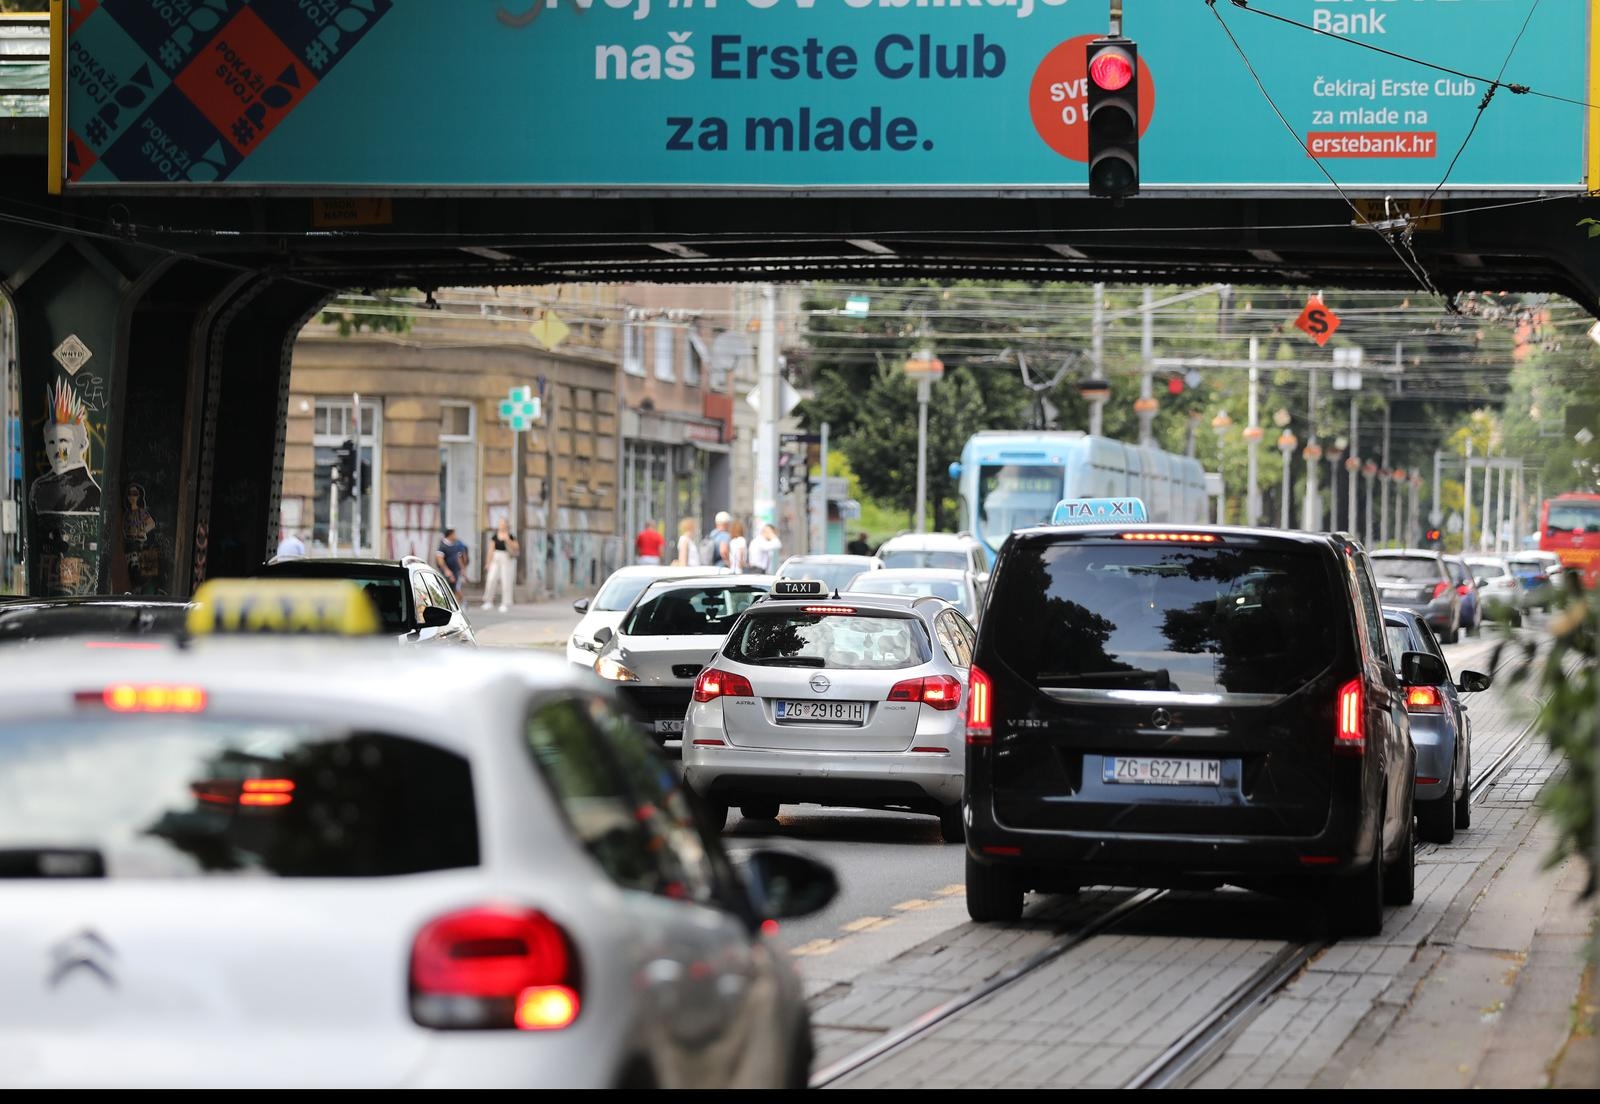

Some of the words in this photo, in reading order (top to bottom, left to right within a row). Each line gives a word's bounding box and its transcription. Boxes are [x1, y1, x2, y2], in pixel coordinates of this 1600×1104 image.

[1313, 8, 1387, 34] Bank
[70, 41, 119, 93] POKAŽI
[216, 41, 265, 93] POKAŽI
[595, 31, 696, 80] naš
[711, 35, 858, 80] Erste
[874, 33, 1007, 80] Club
[69, 65, 107, 104] SVOJ
[216, 64, 255, 104] SVOJ
[1313, 76, 1376, 100] Čekiraj
[1381, 79, 1429, 97] Erste
[1434, 79, 1476, 97] Club
[665, 116, 729, 151] za
[745, 106, 934, 151] mlade.
[1312, 110, 1334, 125] za
[1339, 107, 1399, 125] mlade
[1404, 110, 1428, 125] na
[141, 117, 191, 171] POKAŽI
[1312, 135, 1434, 153] erstebank.hr
[1308, 310, 1329, 334] S
[785, 583, 811, 593] TAXI
[786, 702, 802, 717] ZG
[662, 721, 674, 731] SK
[1117, 759, 1138, 777] ZG
